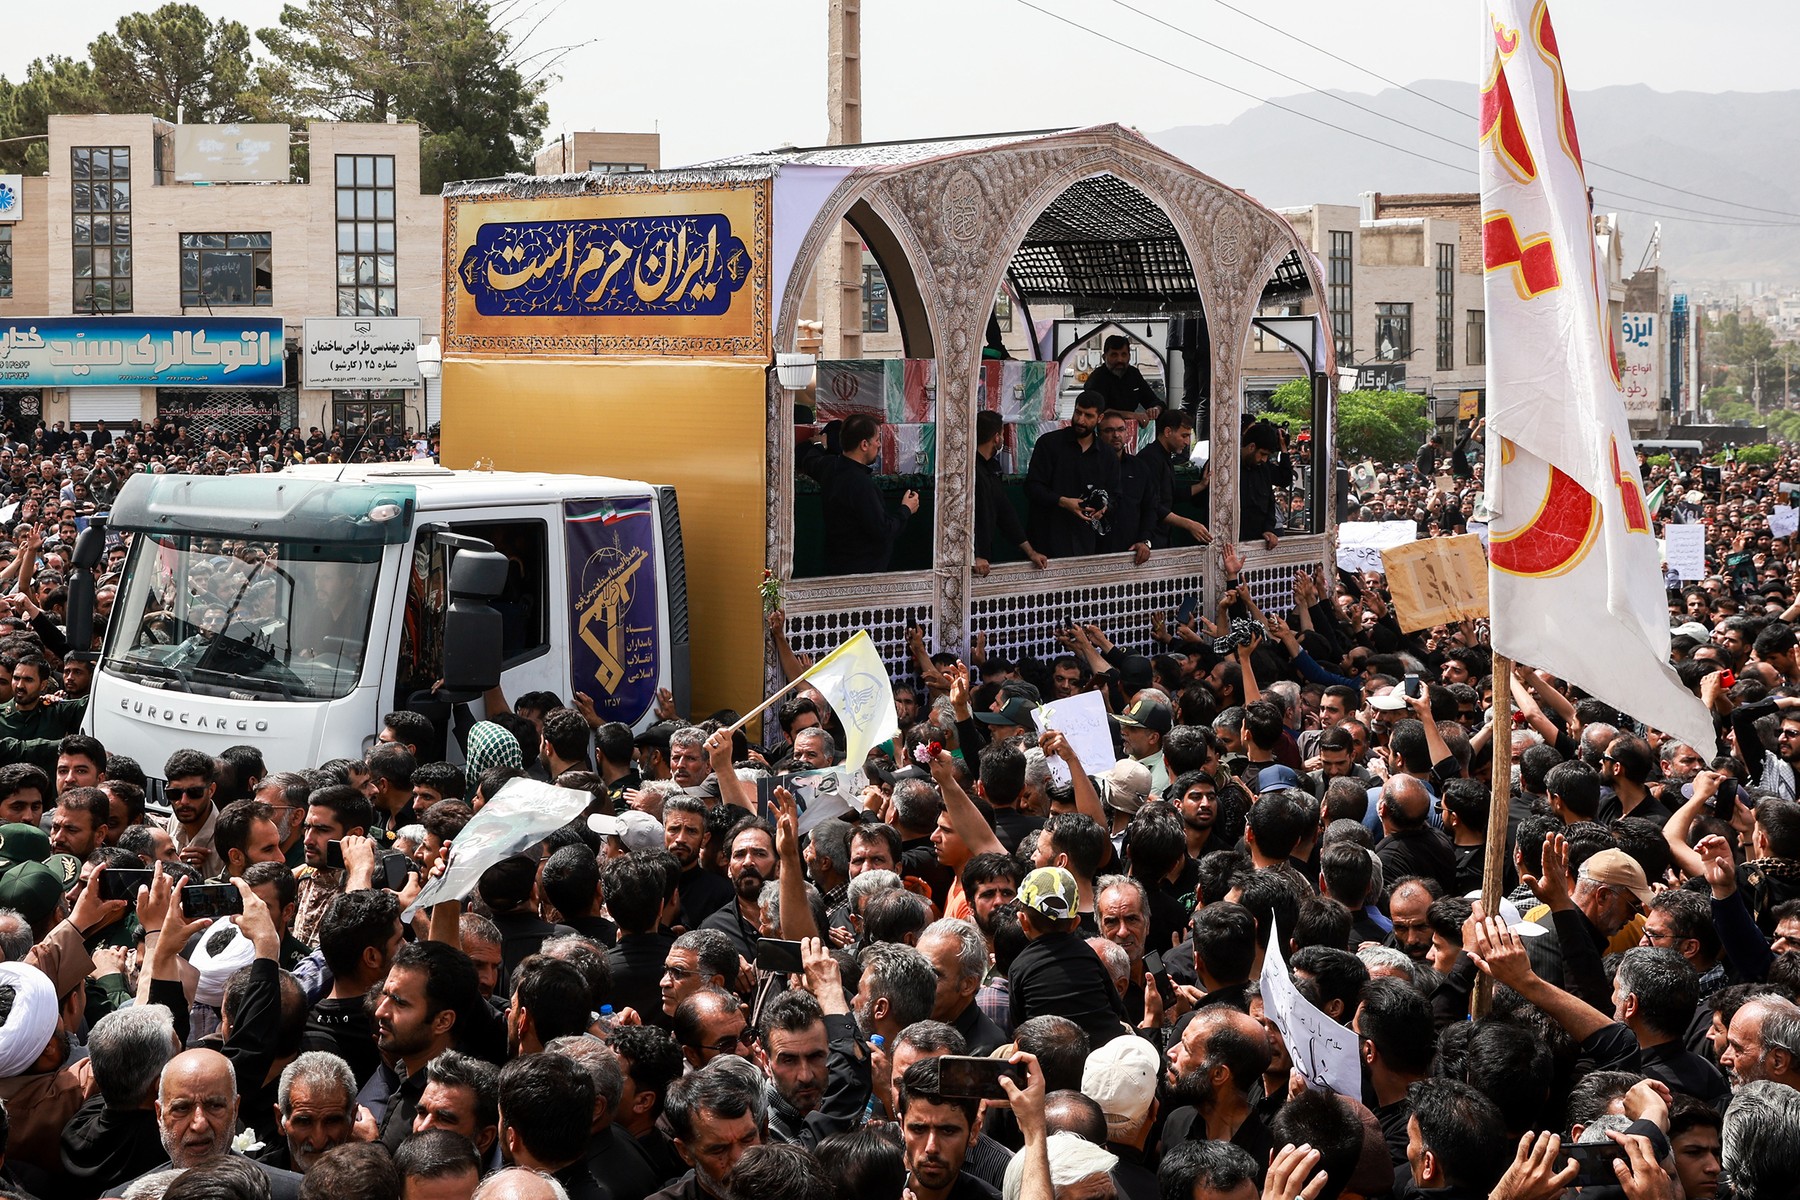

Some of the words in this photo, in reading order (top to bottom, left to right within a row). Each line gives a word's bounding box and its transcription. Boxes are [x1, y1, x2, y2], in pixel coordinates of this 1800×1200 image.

[487, 230, 575, 290] است
[634, 224, 717, 302] ایران
[573, 240, 634, 303] حرم
[310, 340, 342, 355] ساختمان
[342, 340, 370, 355] طراحی
[370, 340, 400, 354] مهندسی
[399, 339, 416, 355] دفتر
[365, 360, 375, 369] ۲۵
[377, 360, 398, 371] شماره
[1631, 363, 1652, 376] انواع
[1375, 370, 1388, 392] اتو
[625, 623, 653, 636] سپاه
[626, 636, 653, 652] پاسداران
[626, 652, 653, 668] انقلاب
[627, 667, 654, 683] اسلامی
[604, 698, 621, 707] ۱۳۵۷
[120, 698, 269, 732] EUROCARGO
